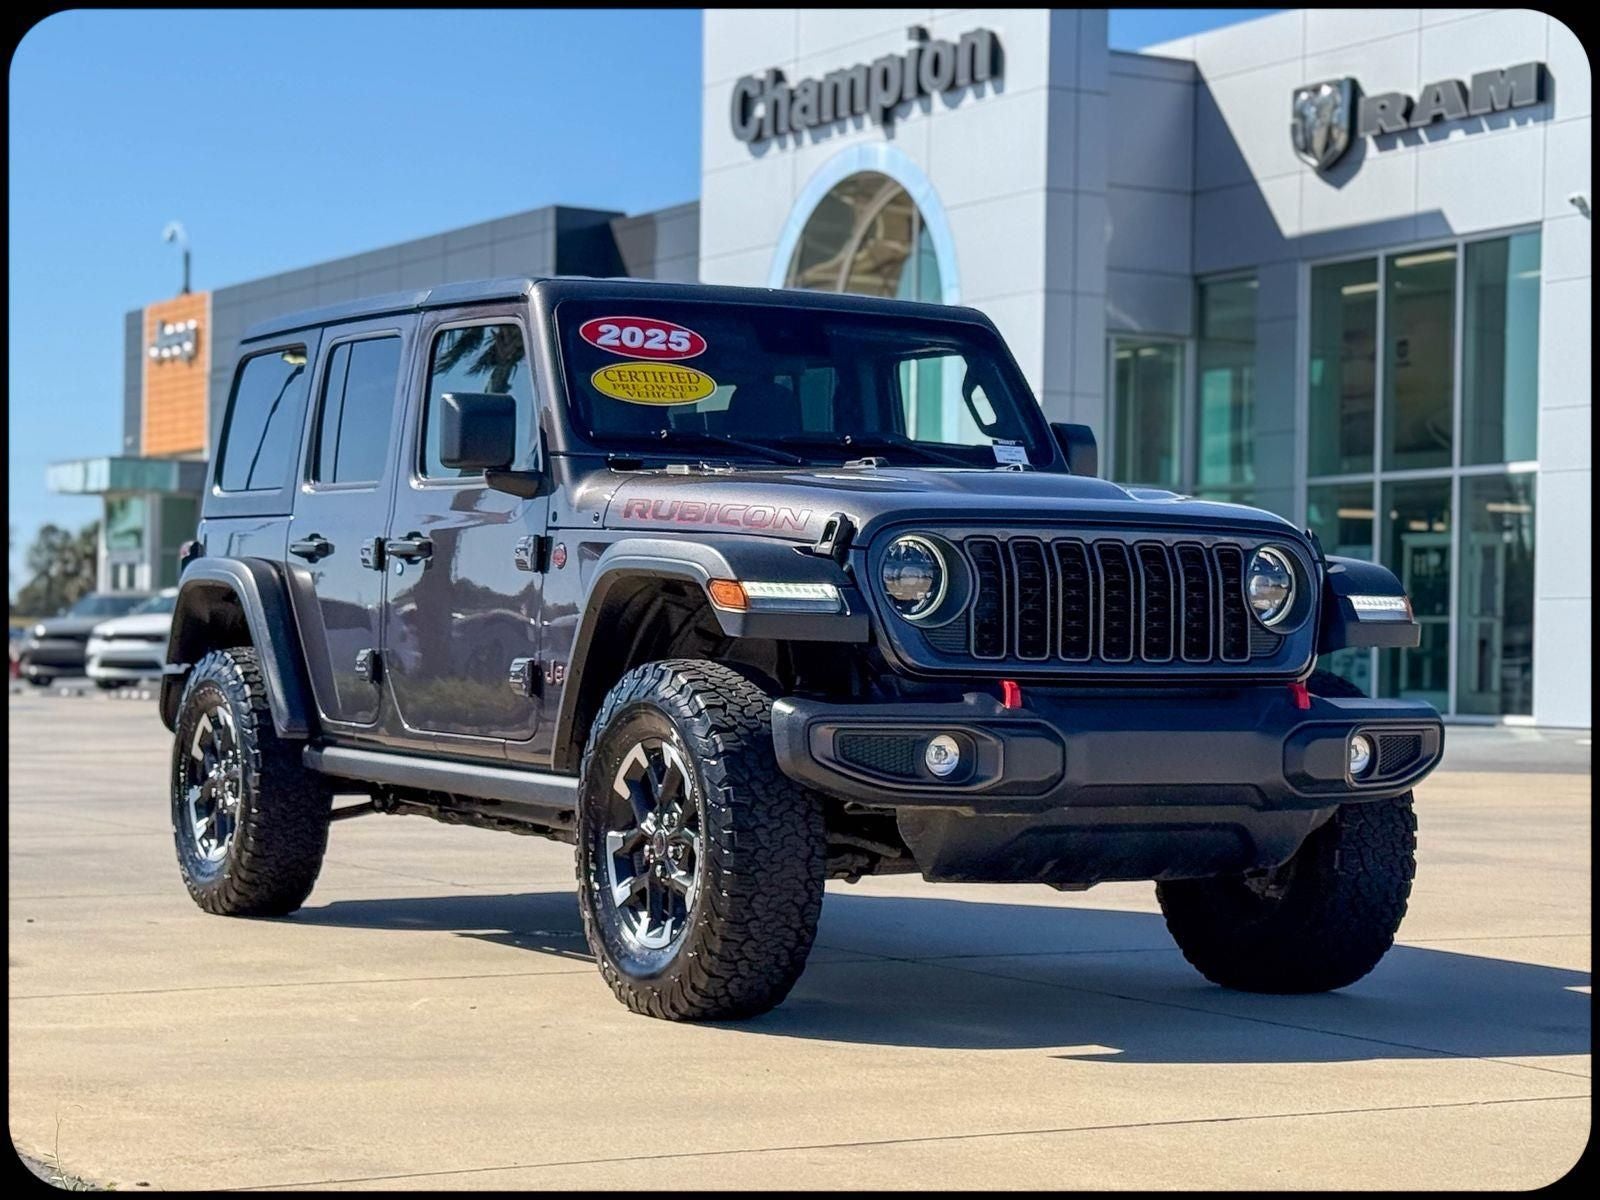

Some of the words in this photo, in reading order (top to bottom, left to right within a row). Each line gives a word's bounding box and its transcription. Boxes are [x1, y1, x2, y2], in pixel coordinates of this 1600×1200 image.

[731, 26, 1001, 142] Champion
[1358, 61, 1546, 137] RAM
[597, 324, 691, 352] 2025
[603, 370, 700, 384] CERTIFIED
[626, 391, 688, 399] VEHICLE
[623, 498, 813, 530] RUBICON
